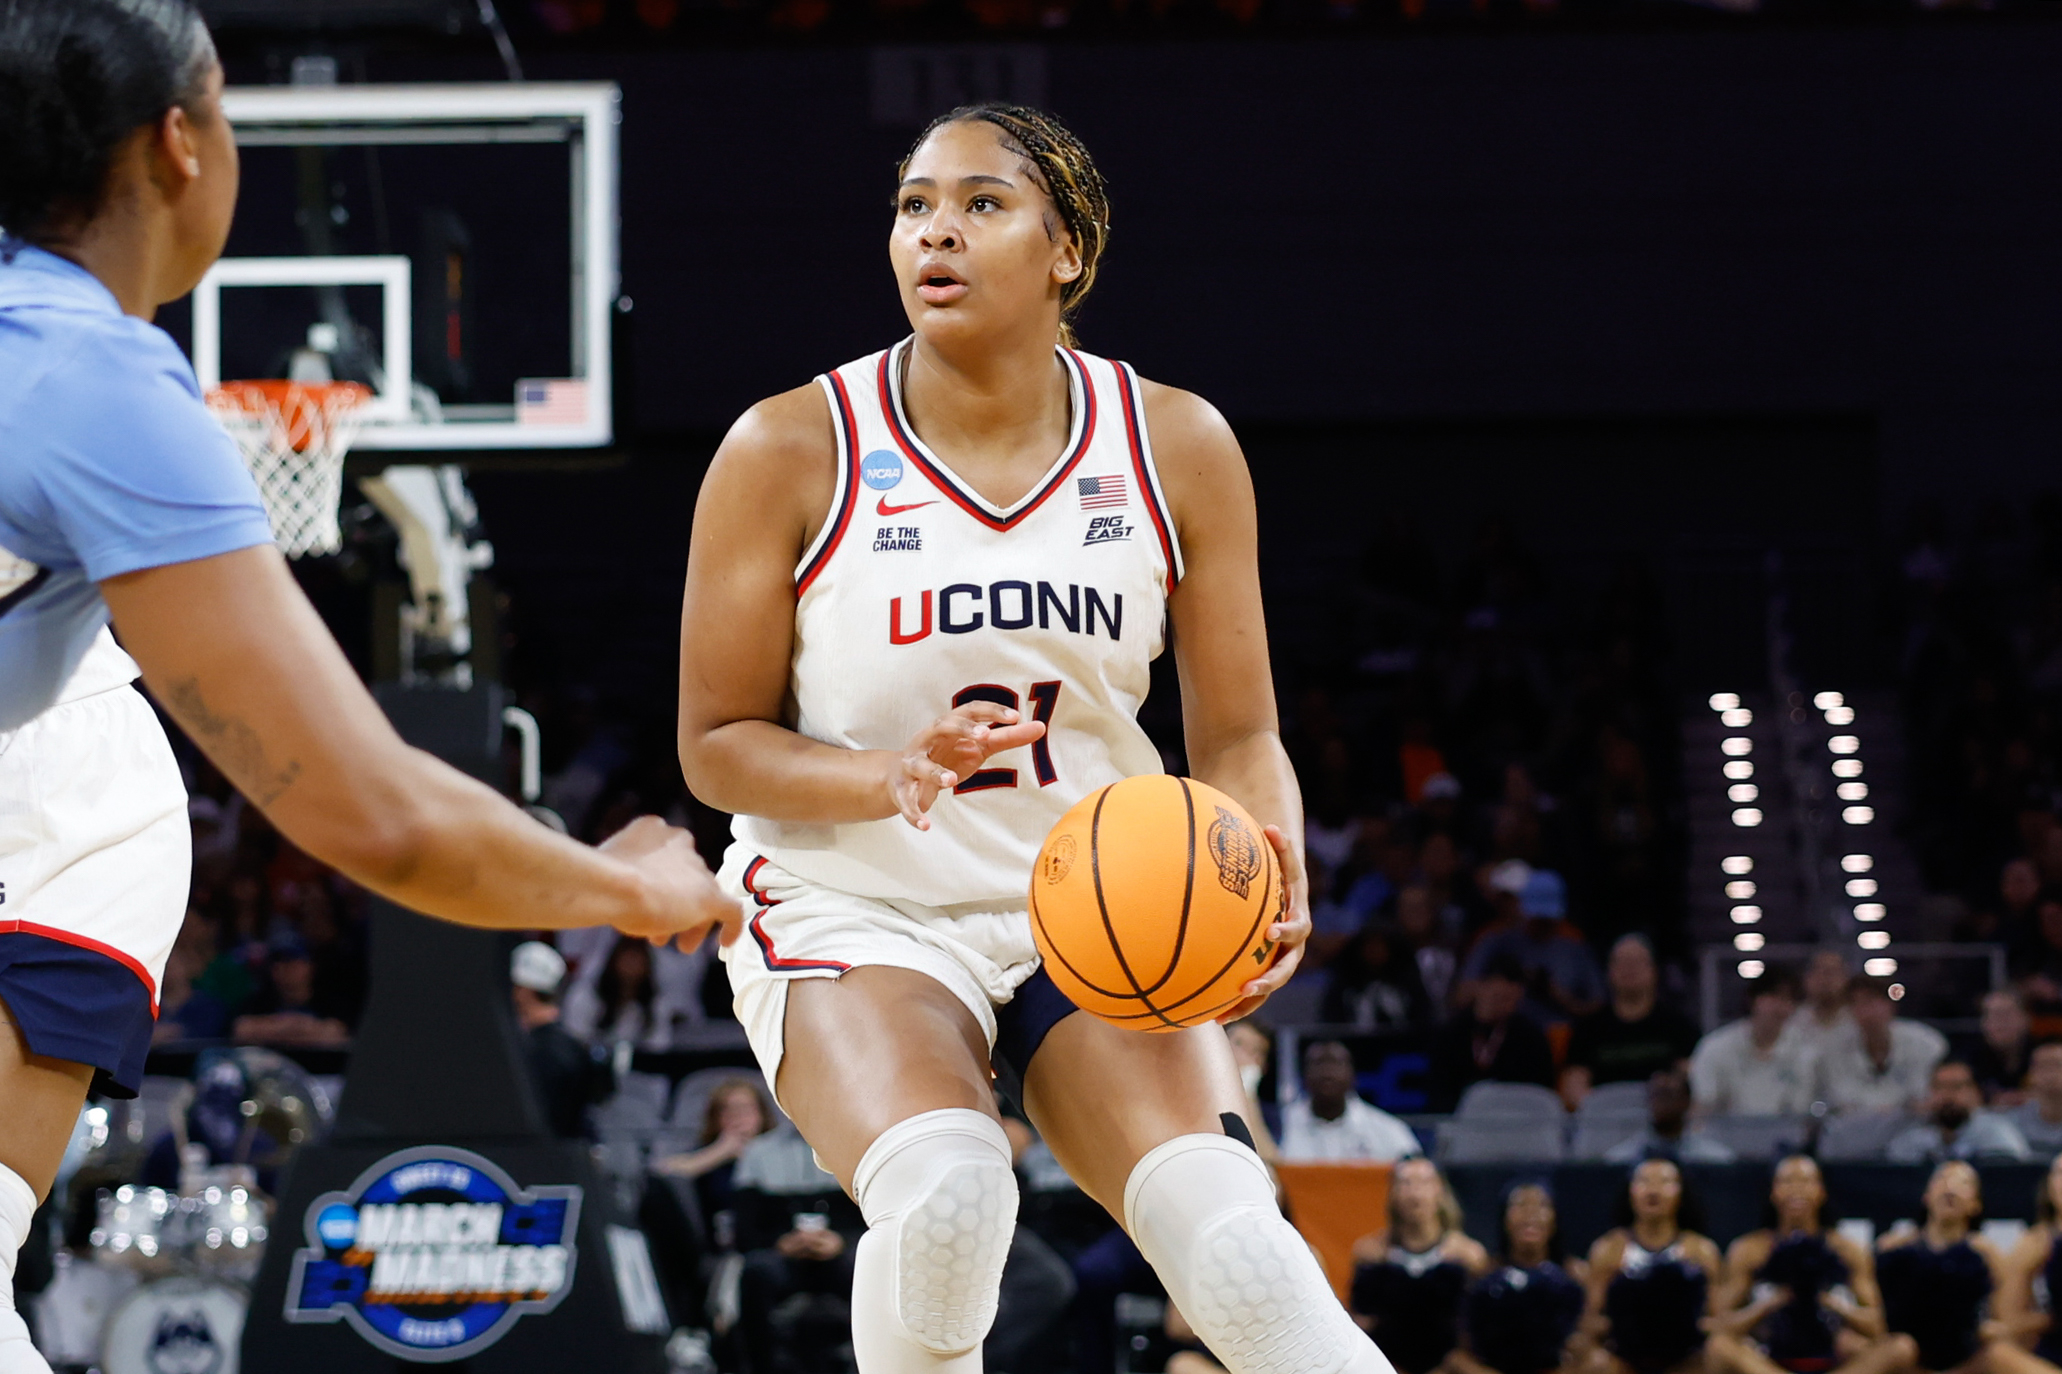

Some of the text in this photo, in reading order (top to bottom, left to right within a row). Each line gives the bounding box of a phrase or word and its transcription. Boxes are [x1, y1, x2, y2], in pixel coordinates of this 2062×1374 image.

[866, 468, 900, 480] NCAA
[1089, 515, 1124, 529] BIG
[877, 527, 920, 539] BE THE
[1085, 526, 1135, 540] EAST
[872, 539, 922, 552] CHANGE
[889, 580, 1122, 645] UCONN
